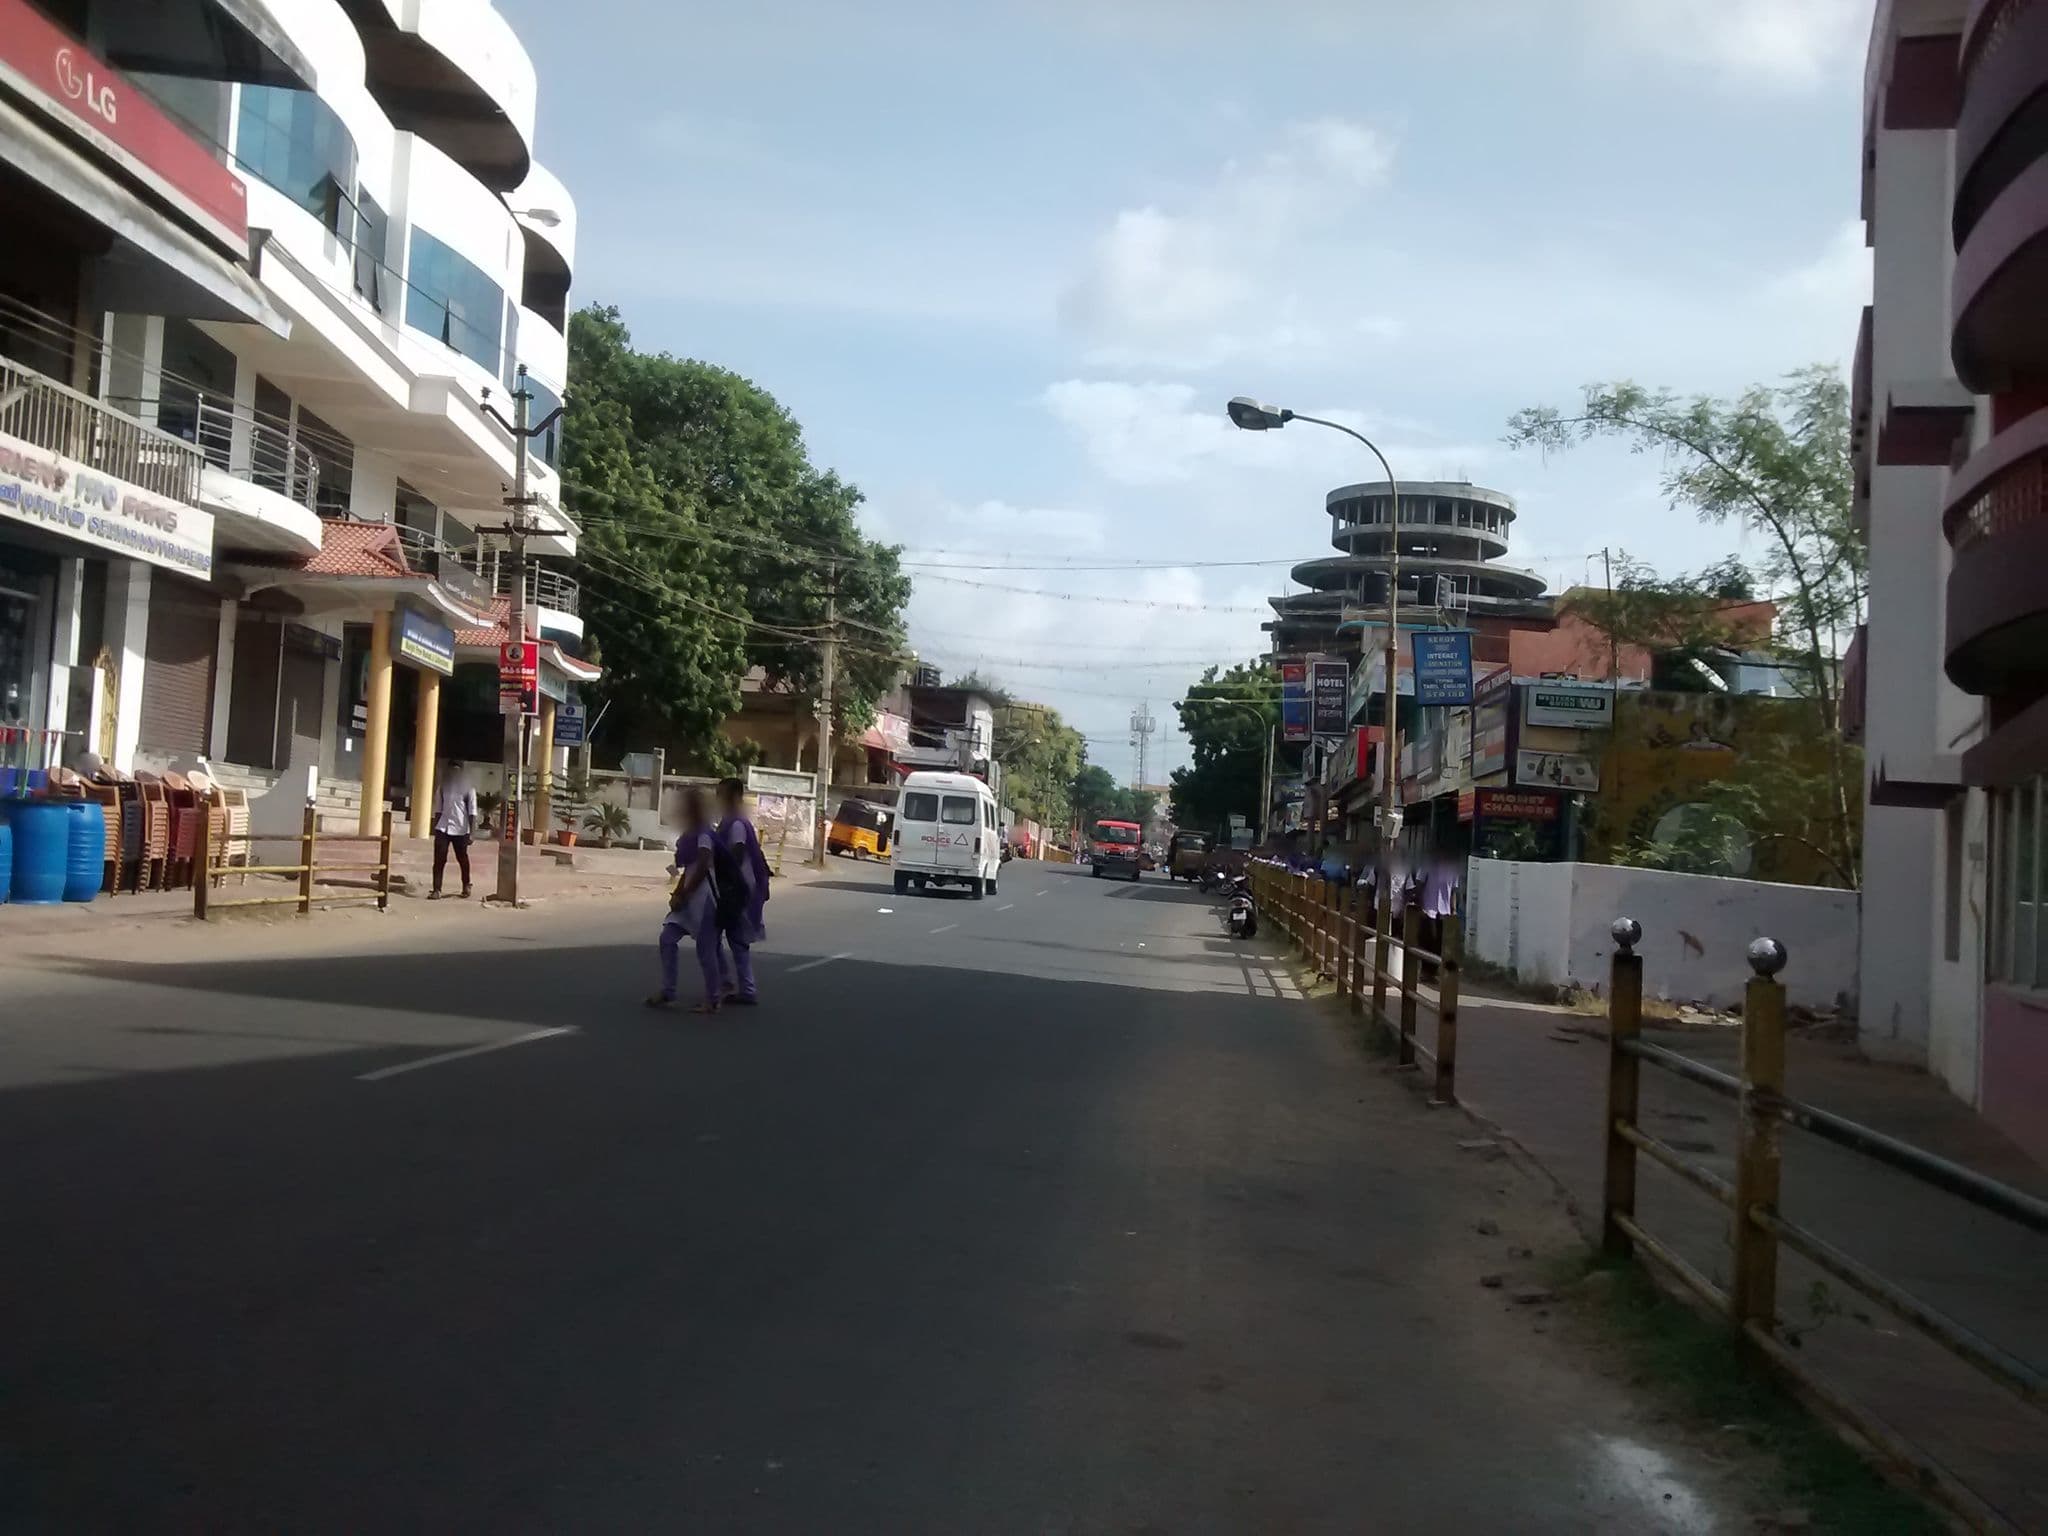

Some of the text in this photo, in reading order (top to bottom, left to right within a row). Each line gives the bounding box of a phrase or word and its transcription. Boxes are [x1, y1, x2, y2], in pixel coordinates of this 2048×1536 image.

[87, 73, 117, 124] LG
[1316, 678, 1345, 687] HOTEL
[1491, 792, 1546, 803] MONEY
[1483, 803, 1554, 815] CHANGER
[921, 835, 951, 844] POLICE
